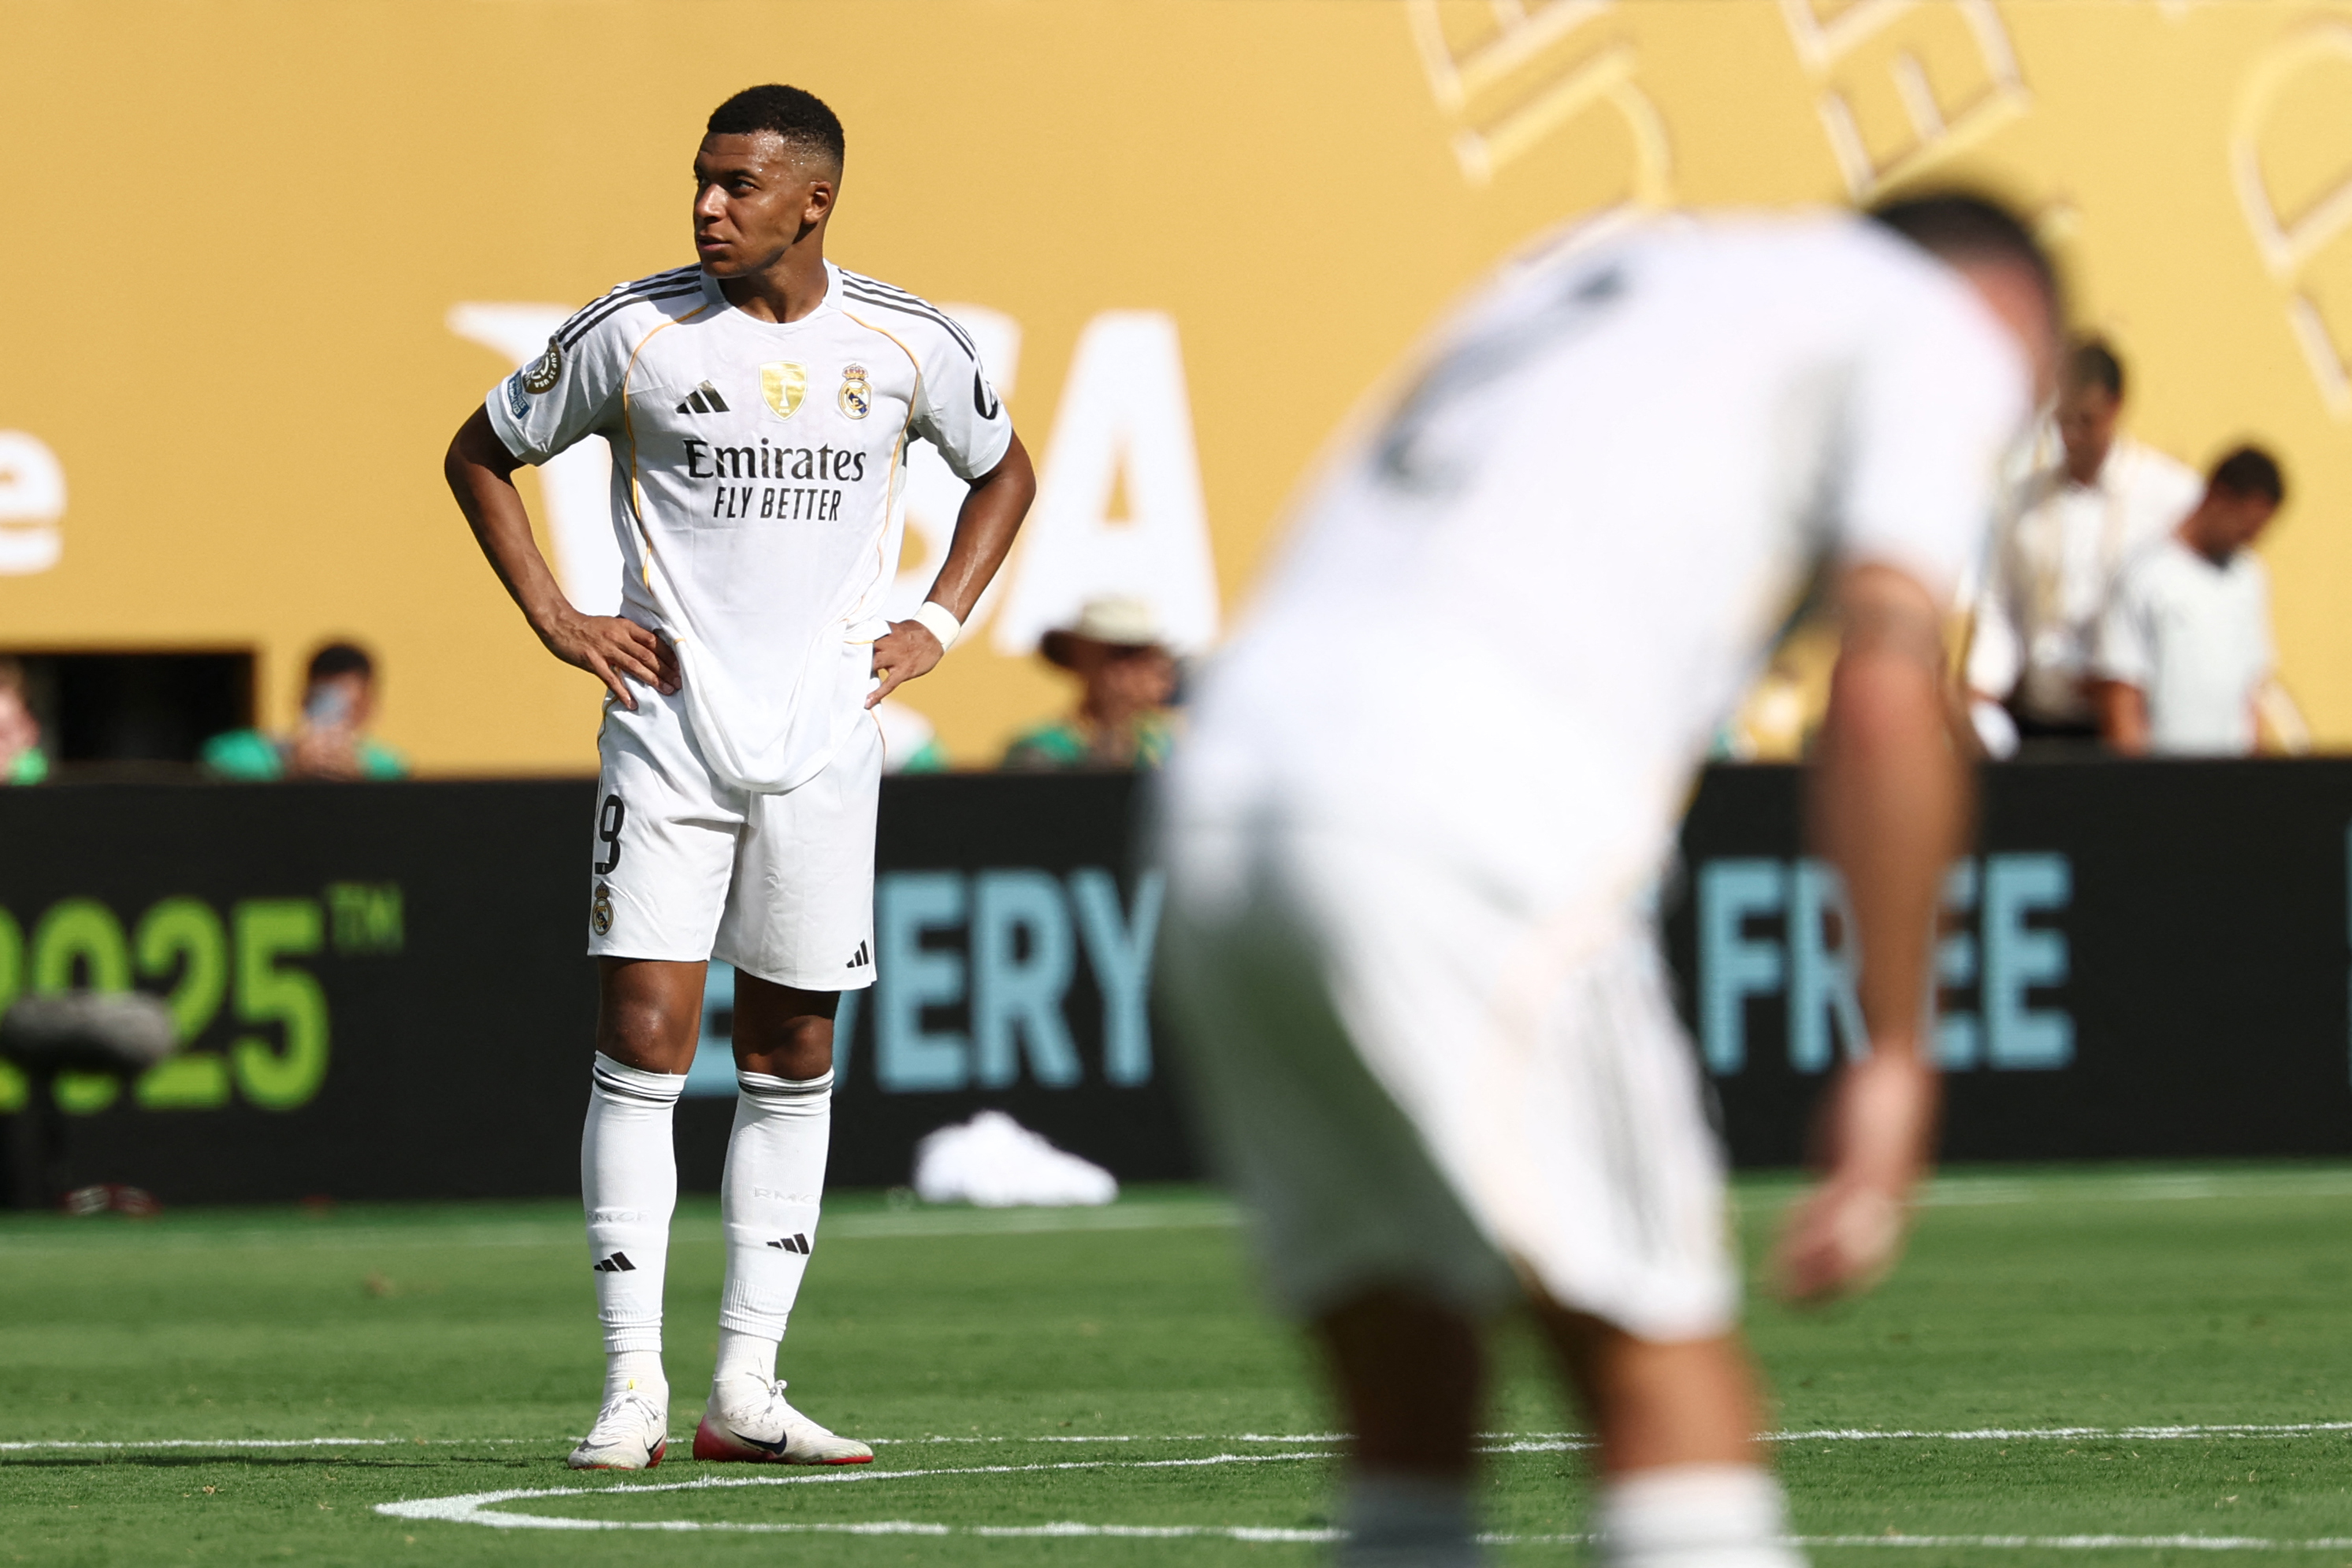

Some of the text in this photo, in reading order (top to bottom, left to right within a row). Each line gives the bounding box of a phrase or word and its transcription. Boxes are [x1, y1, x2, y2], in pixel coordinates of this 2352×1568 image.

[534, 378, 550, 388] USA
[683, 437, 867, 481] Emirates
[445, 307, 1219, 656] VA
[713, 486, 842, 521] FLY BETTER
[595, 794, 625, 875] 9
[685, 870, 1166, 1095] ERY
[754, 1186, 820, 1205] RMC
